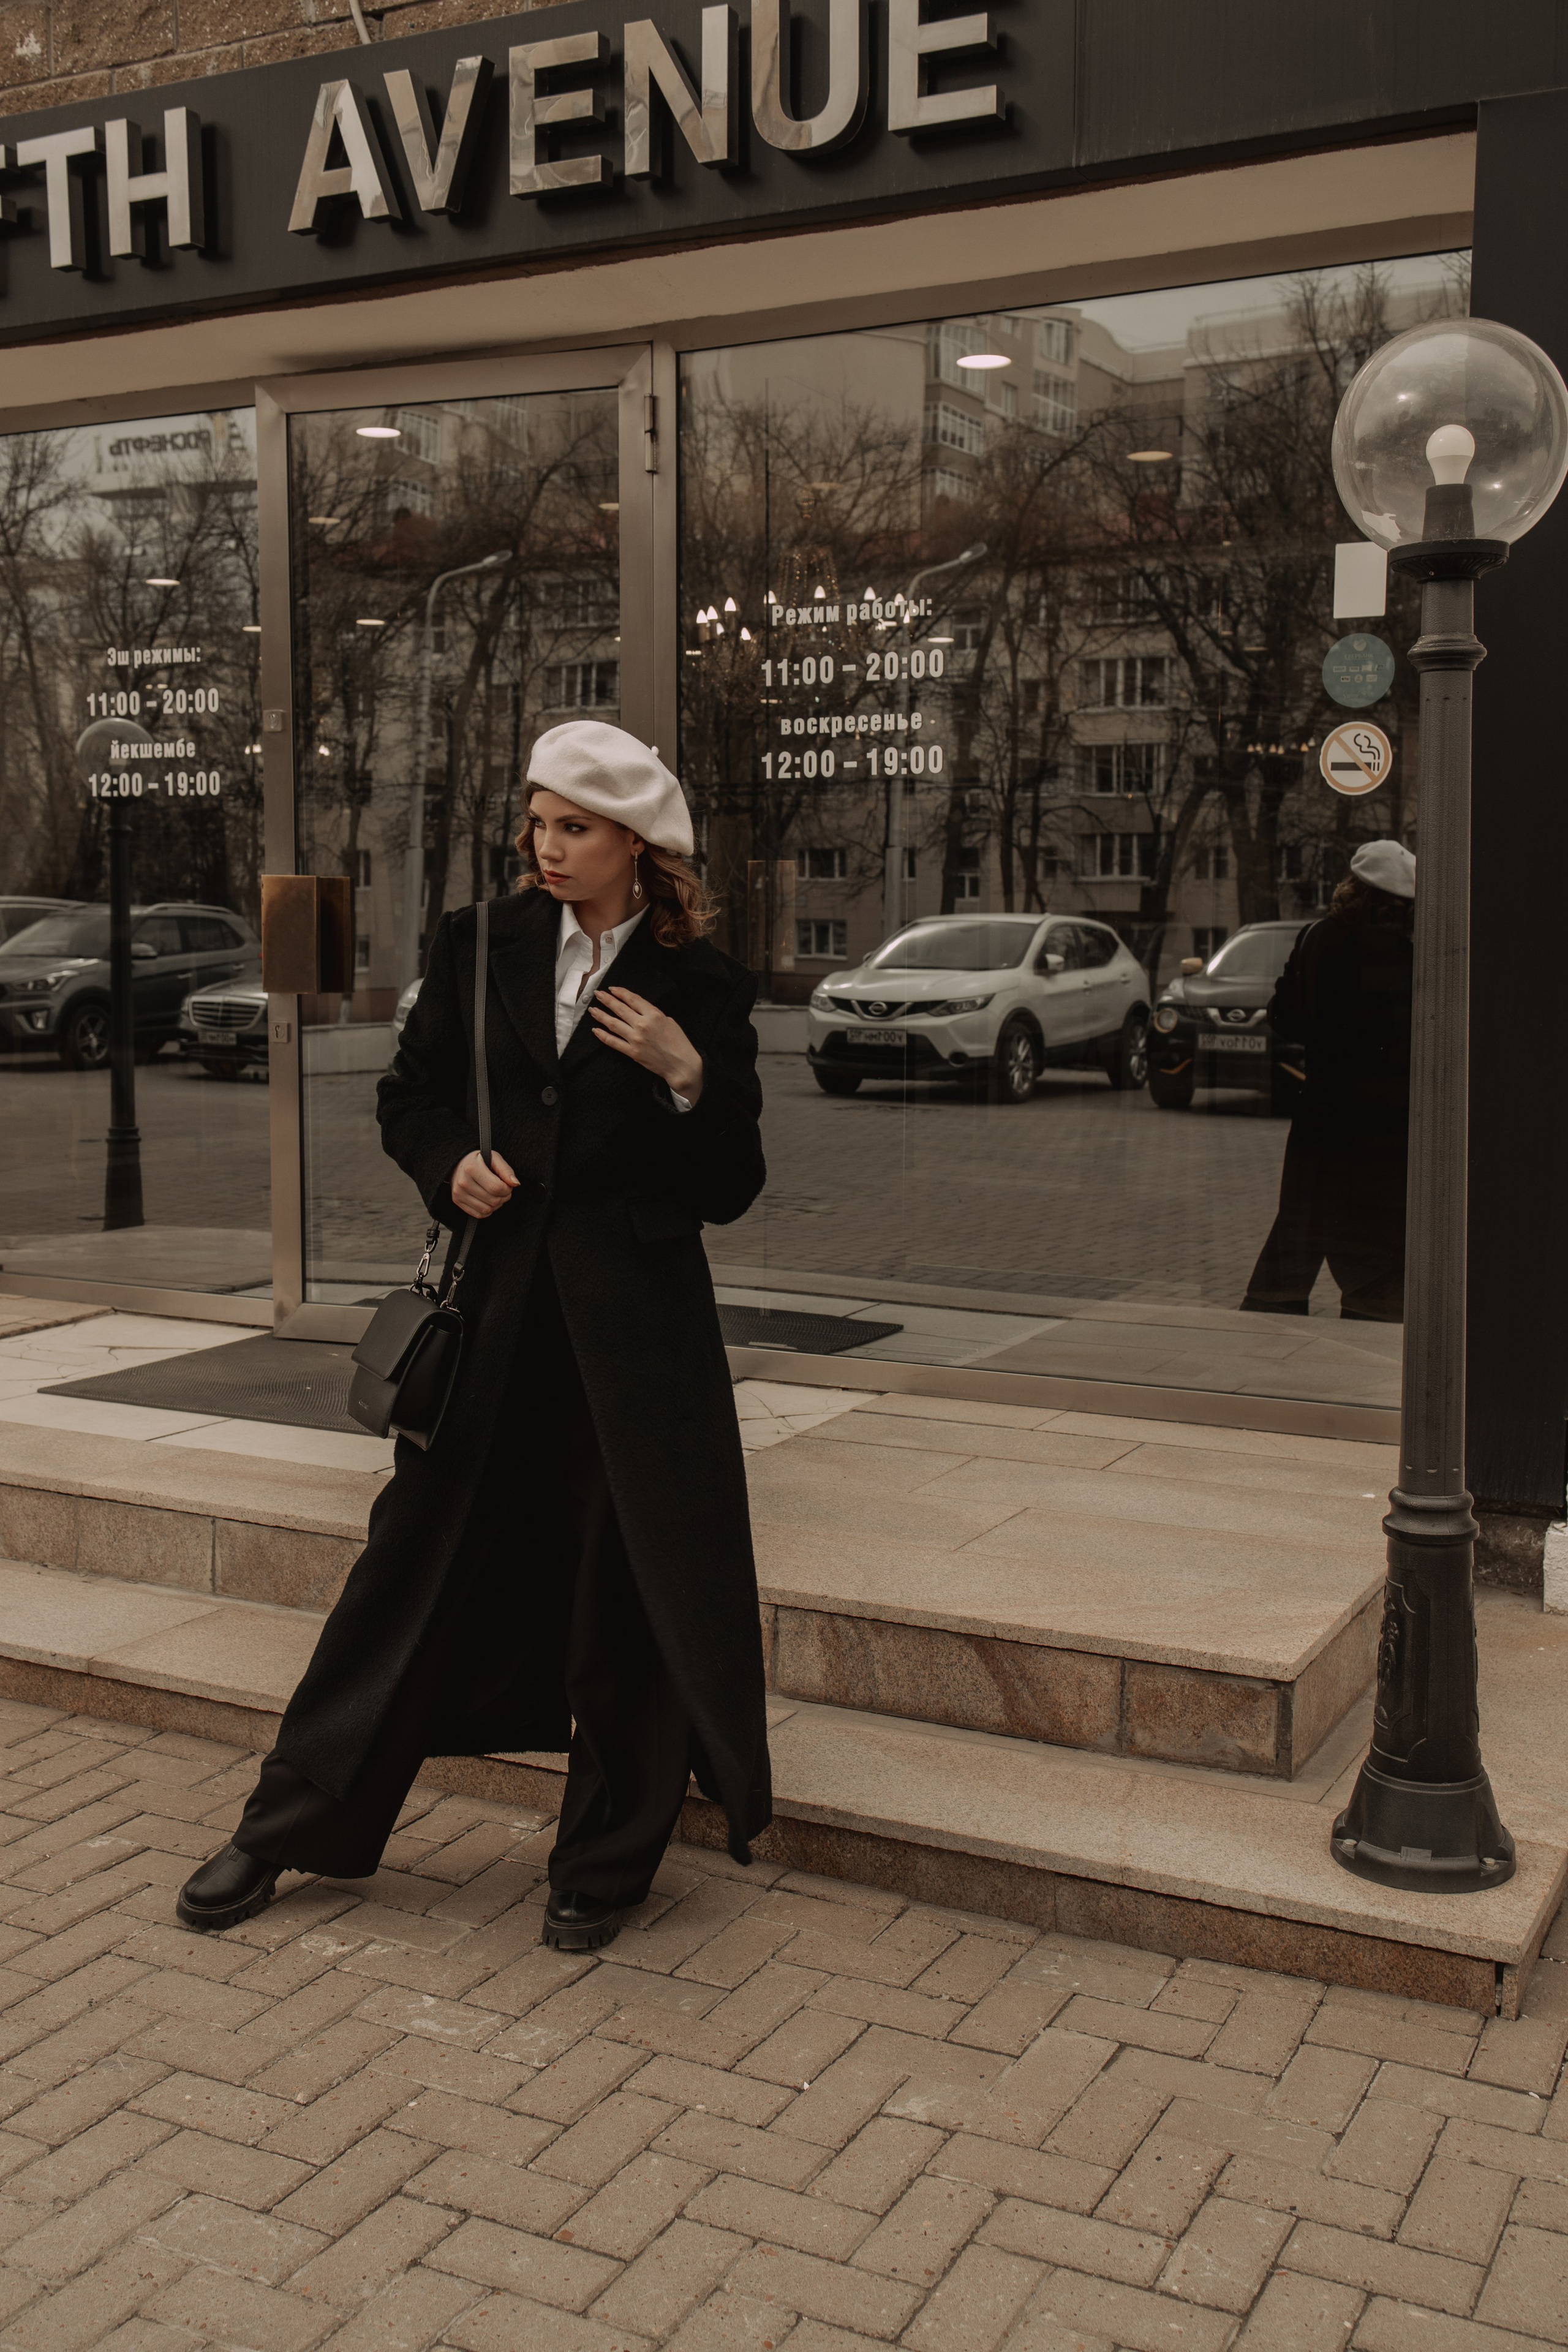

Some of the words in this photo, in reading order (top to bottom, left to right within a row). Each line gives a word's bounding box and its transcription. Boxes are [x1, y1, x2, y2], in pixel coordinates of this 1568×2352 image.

[0, 105, 195, 270] TH
[287, 0, 1000, 235] AVENUE
[772, 605, 840, 626] Режим
[846, 598, 933, 626] работы:
[107, 647, 129, 666] Эш
[134, 647, 201, 669] режимы:
[761, 655, 834, 687] 11:00
[866, 648, 944, 681] 20:00
[86, 691, 140, 717] 11:00
[162, 687, 219, 714] 20:00
[781, 712, 922, 737] воскресенье
[110, 737, 195, 760] йекшембе
[761, 750, 835, 779] 12:00
[866, 745, 943, 775] 19:00
[88, 772, 142, 797] 12:00
[164, 771, 220, 796] 19:00
